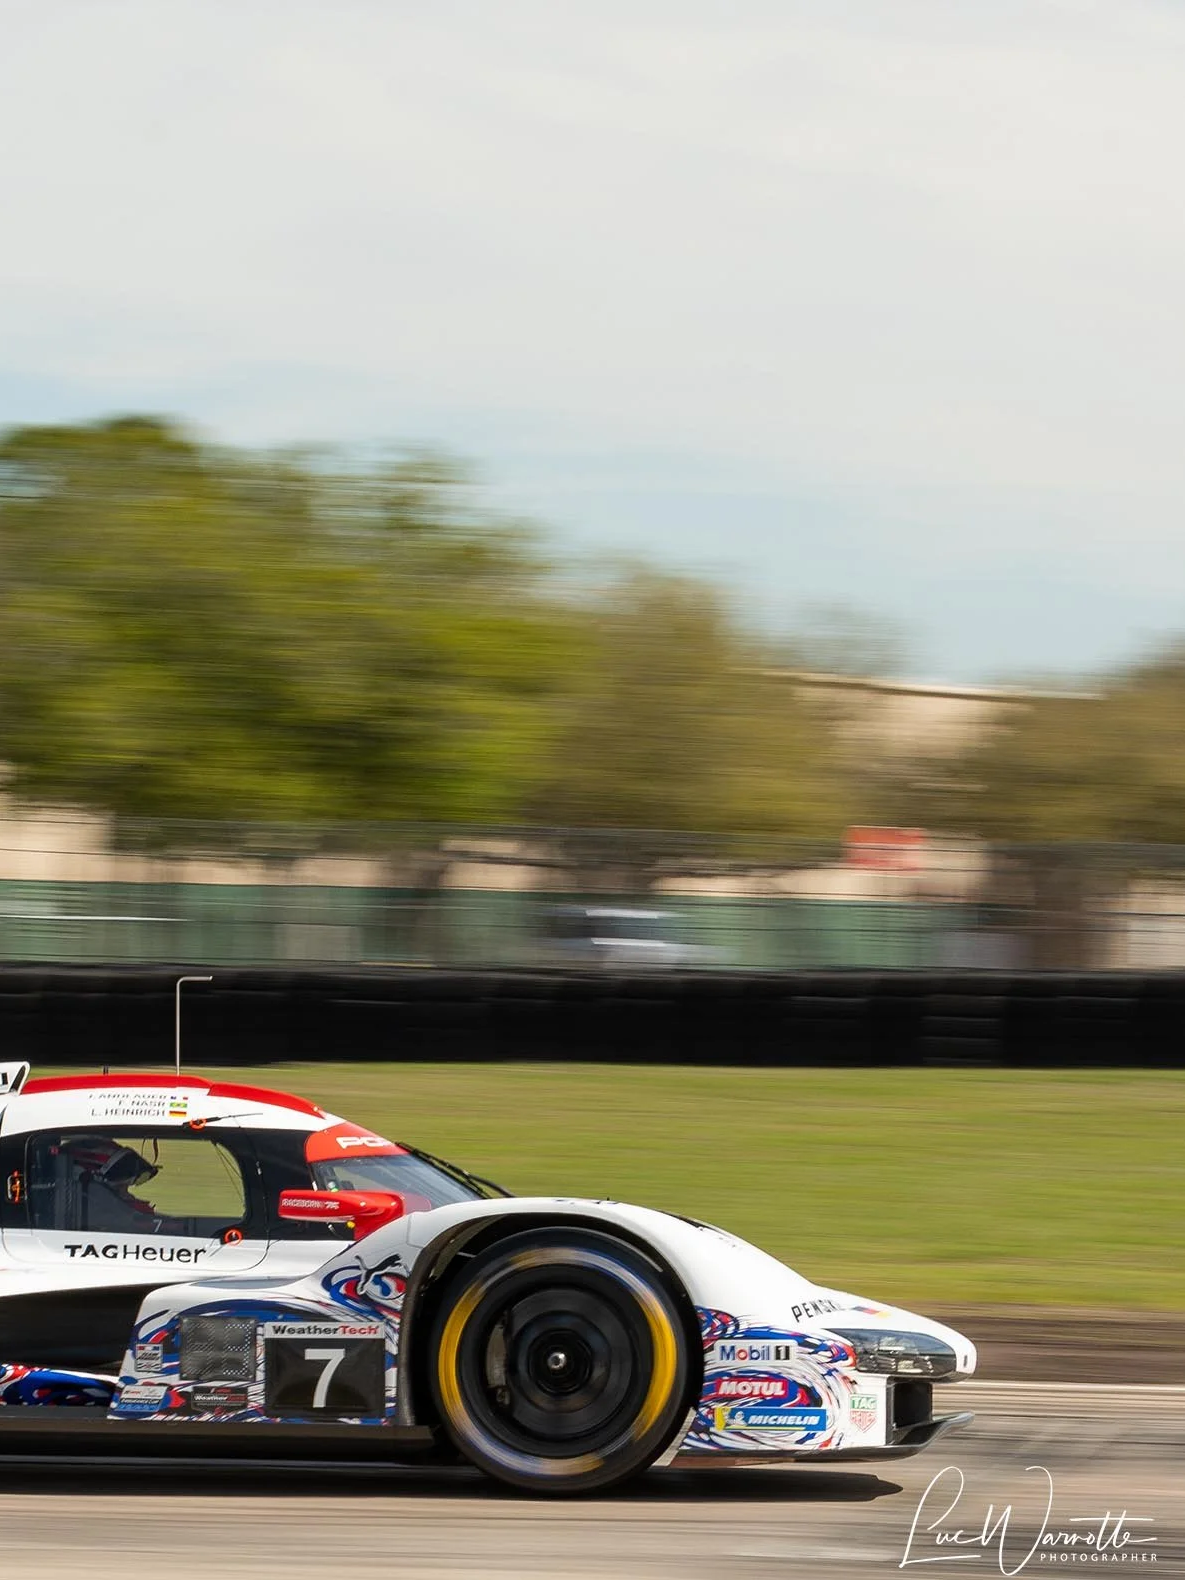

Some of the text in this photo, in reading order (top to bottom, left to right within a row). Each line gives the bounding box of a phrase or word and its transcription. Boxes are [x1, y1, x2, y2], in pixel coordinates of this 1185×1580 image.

[105, 1108, 166, 1117] HEINRICH
[153, 1219, 163, 1233] 7
[272, 1325, 379, 1335] WeatherTech
[719, 1346, 770, 1361] Mobil
[304, 1348, 346, 1408] 7
[718, 1382, 785, 1396] MOTUL
[853, 1399, 876, 1409] TAG
[748, 1415, 820, 1426] MICHELIN
